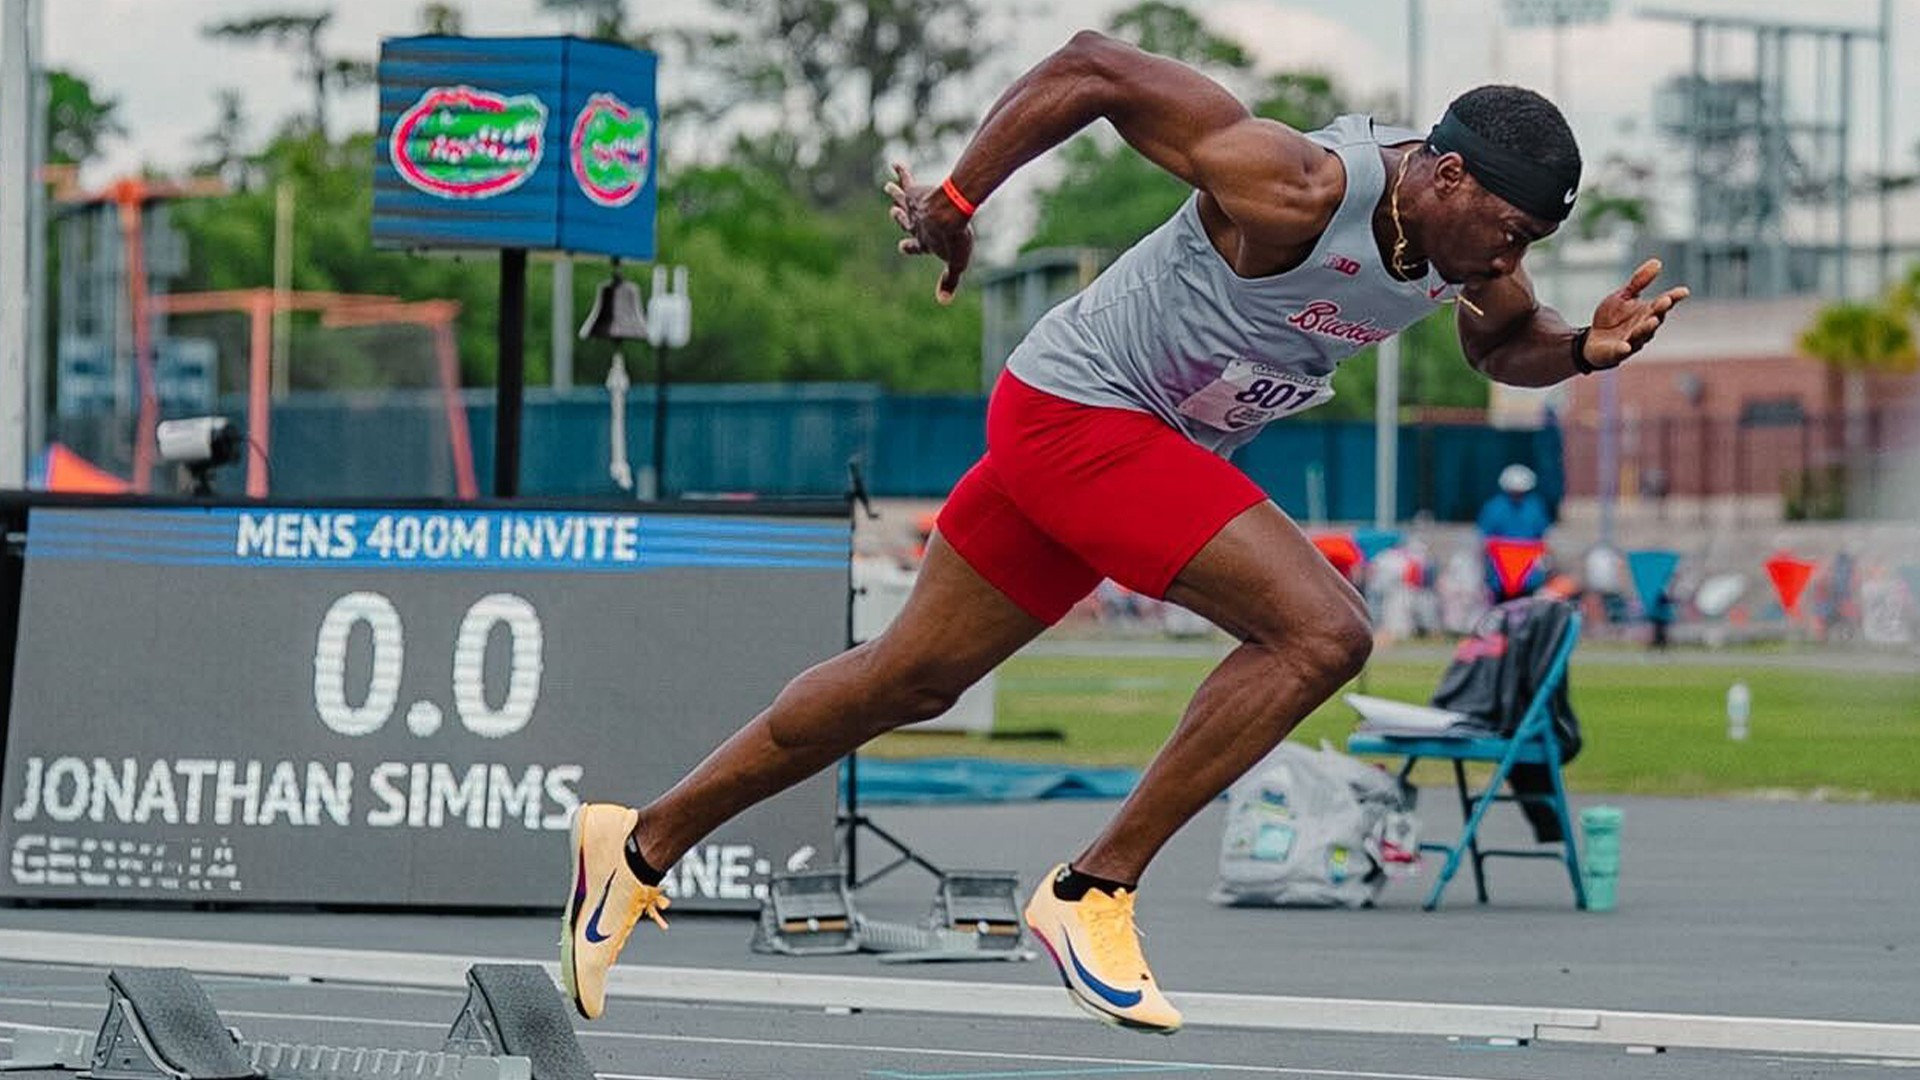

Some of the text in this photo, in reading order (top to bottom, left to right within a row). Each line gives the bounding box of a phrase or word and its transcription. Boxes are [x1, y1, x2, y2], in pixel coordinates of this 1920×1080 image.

[1234, 378, 1318, 410] 801
[236, 513, 639, 562] MENS 400M INVITE
[313, 591, 543, 739] 0.0
[13, 756, 584, 830] JONATHAN SIMMS
